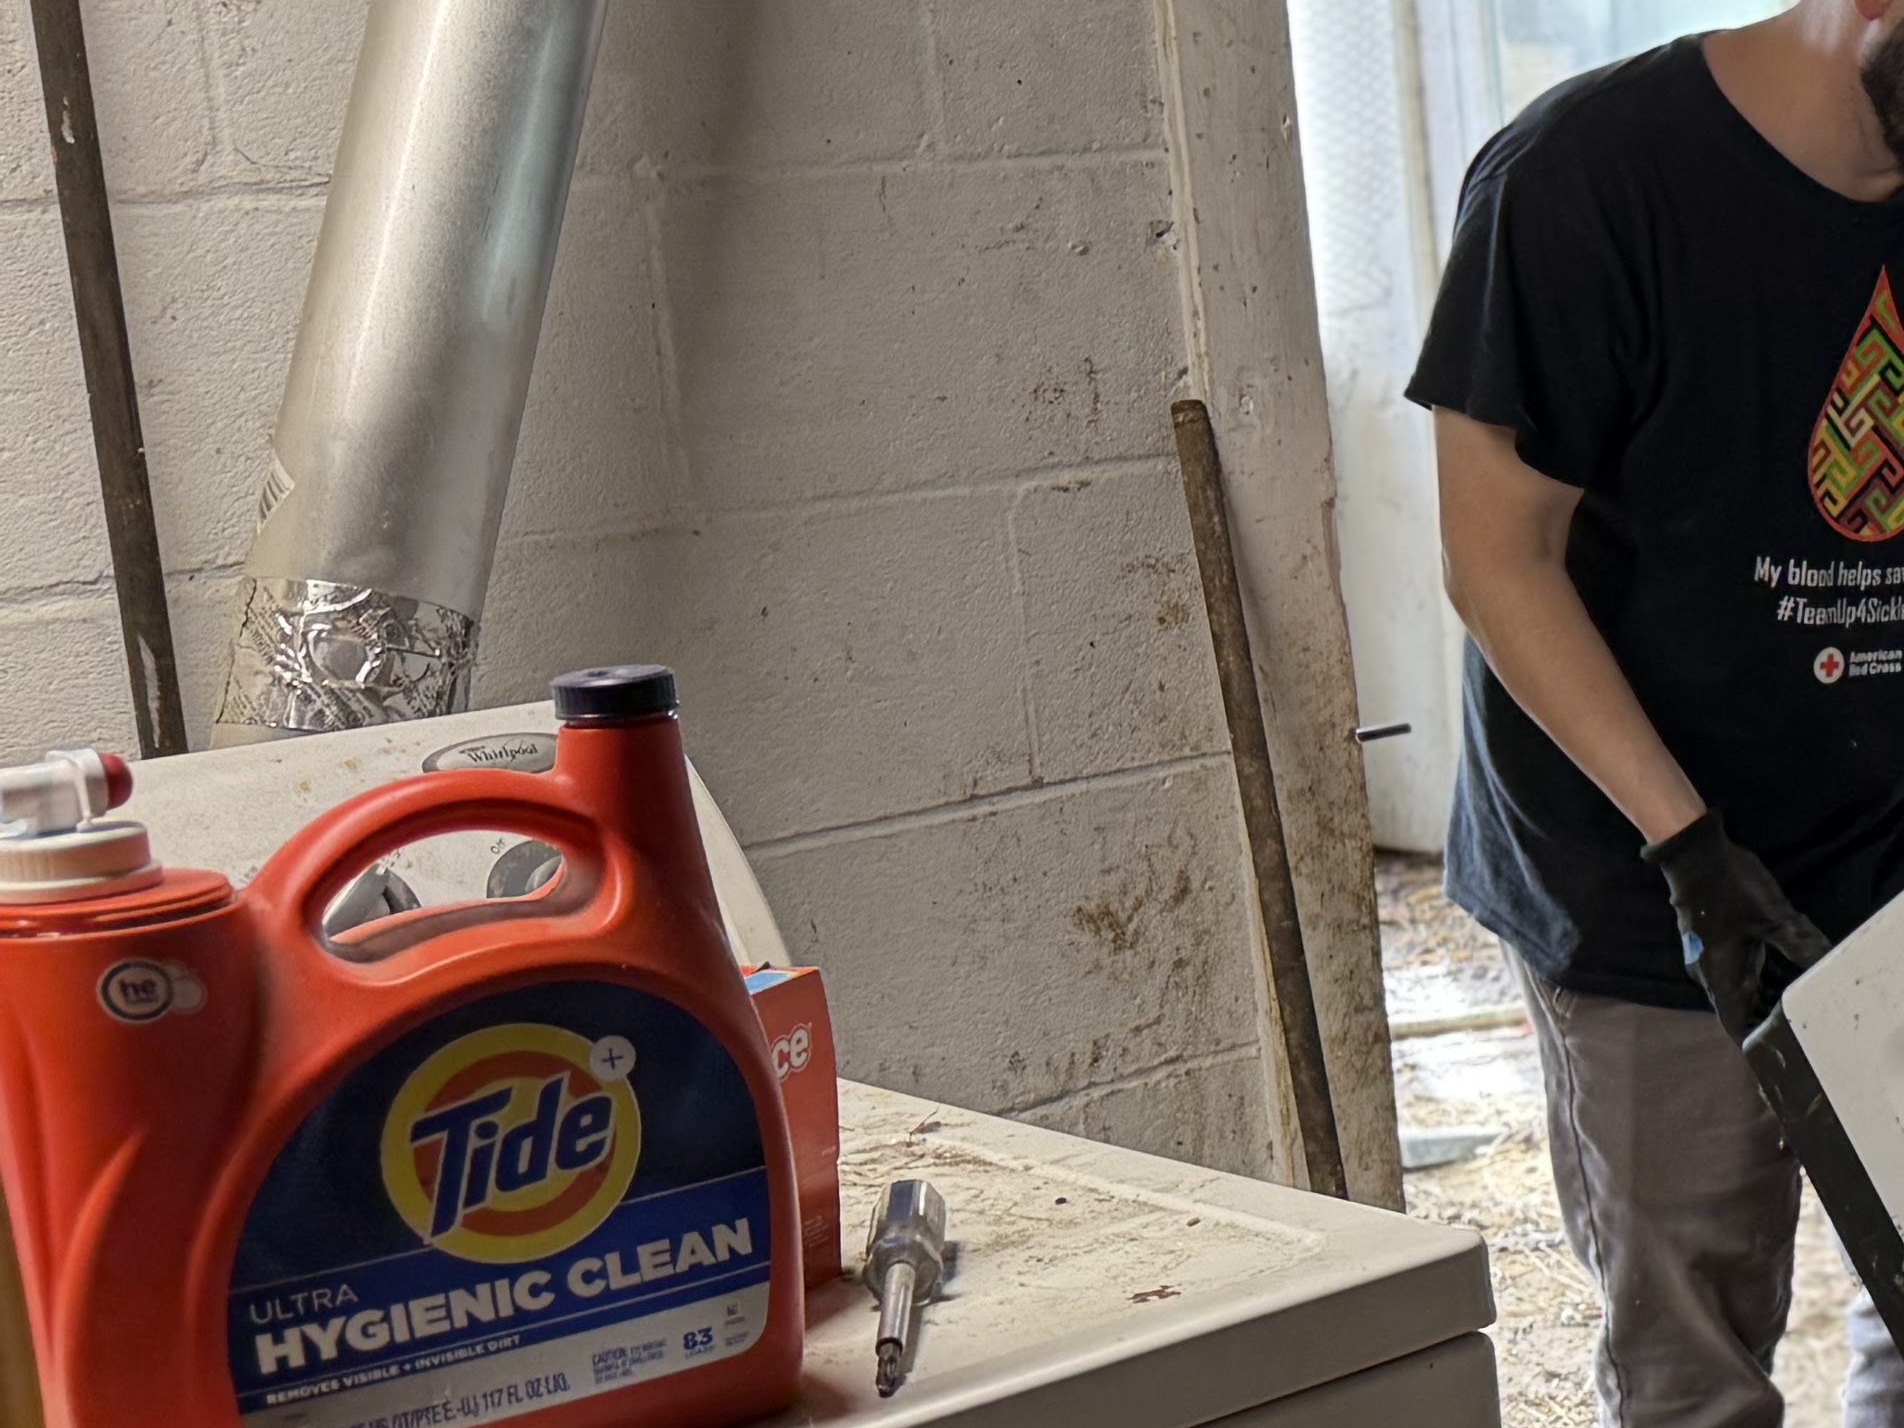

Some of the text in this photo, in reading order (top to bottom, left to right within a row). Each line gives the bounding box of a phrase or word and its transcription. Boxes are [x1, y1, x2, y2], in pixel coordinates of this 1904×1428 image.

[1754, 556, 1782, 588] My
[1787, 558, 1835, 587] blood
[1837, 561, 1881, 590] helps
[1849, 649, 1903, 663] American
[1849, 662, 1902, 677] Red Cross
[467, 739, 538, 763] Whirlpool
[772, 1026, 810, 1076] ce
[409, 1071, 616, 1244] Tide
[251, 1284, 358, 1323] ULTRA
[255, 1270, 556, 1374] HYGIENIC
[567, 1217, 753, 1298] CLEAN
[683, 1327, 714, 1350] 83
[266, 1378, 340, 1405] REMOVES
[342, 1363, 399, 1388] VISIBLE
[415, 1343, 485, 1370] INVISIBLE
[488, 1334, 521, 1350] DIRT
[482, 1389, 505, 1413] 117
[507, 1384, 524, 1406] FL
